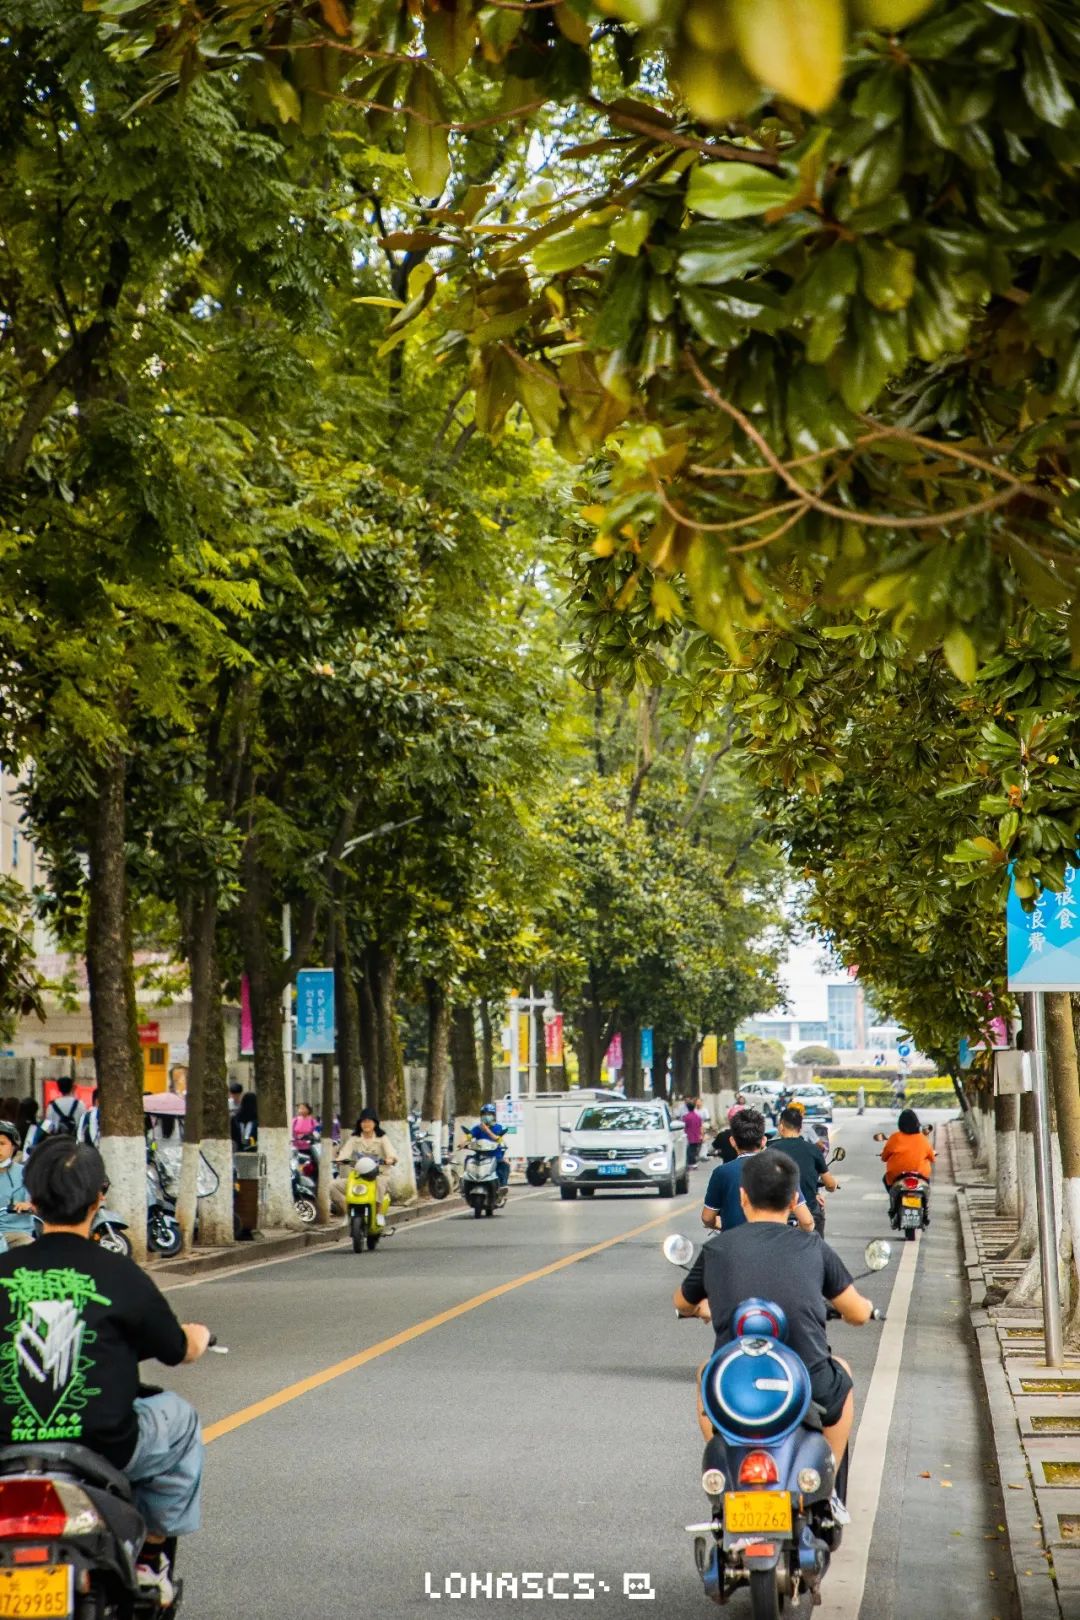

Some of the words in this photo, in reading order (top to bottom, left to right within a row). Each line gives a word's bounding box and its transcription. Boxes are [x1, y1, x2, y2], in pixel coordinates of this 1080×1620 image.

[37, 1425, 83, 1440] DANCE
[731, 1511, 787, 1528] 3202262
[0, 1591, 65, 1614] 729985
